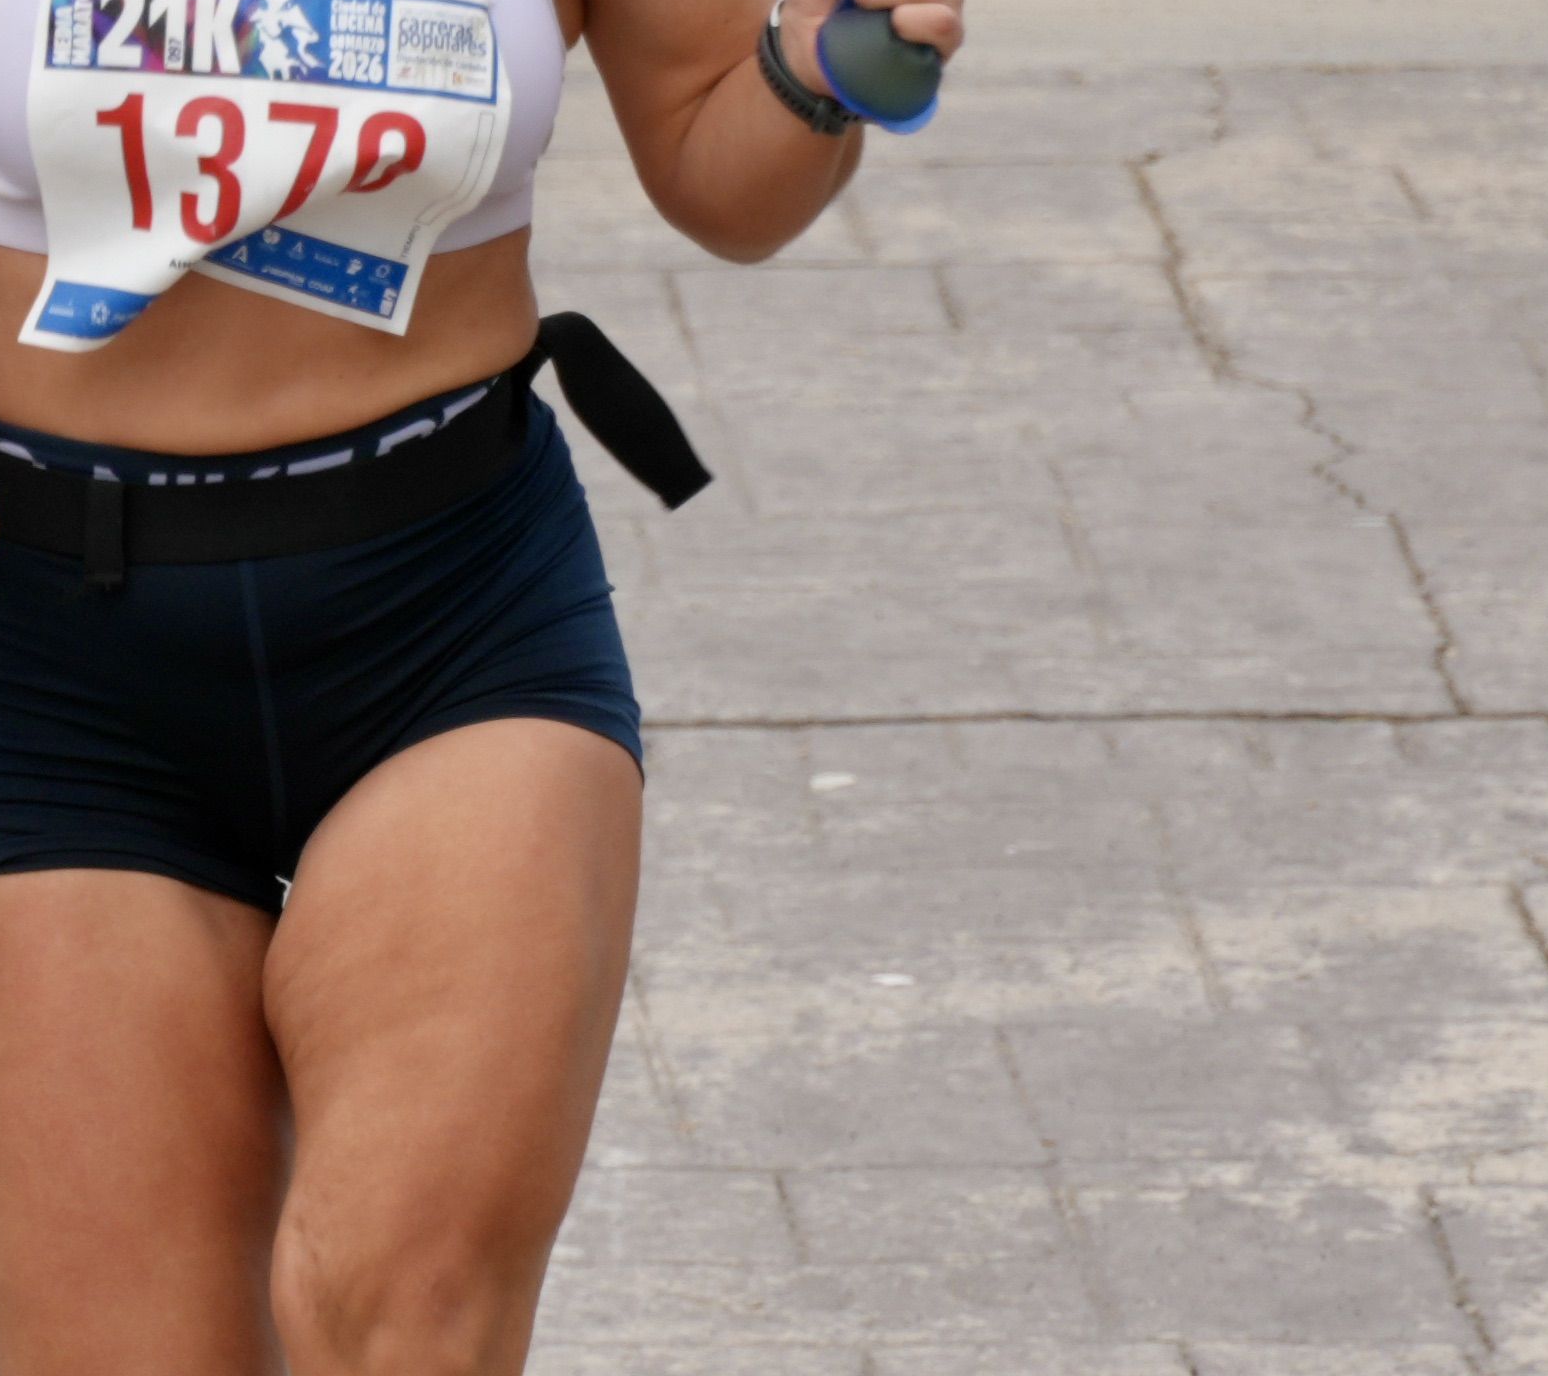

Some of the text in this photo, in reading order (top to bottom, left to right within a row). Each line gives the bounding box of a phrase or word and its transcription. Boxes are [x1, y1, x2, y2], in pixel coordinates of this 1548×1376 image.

[398, 17, 473, 38] carreras
[397, 31, 487, 56] populares
[328, 51, 384, 83] 2026
